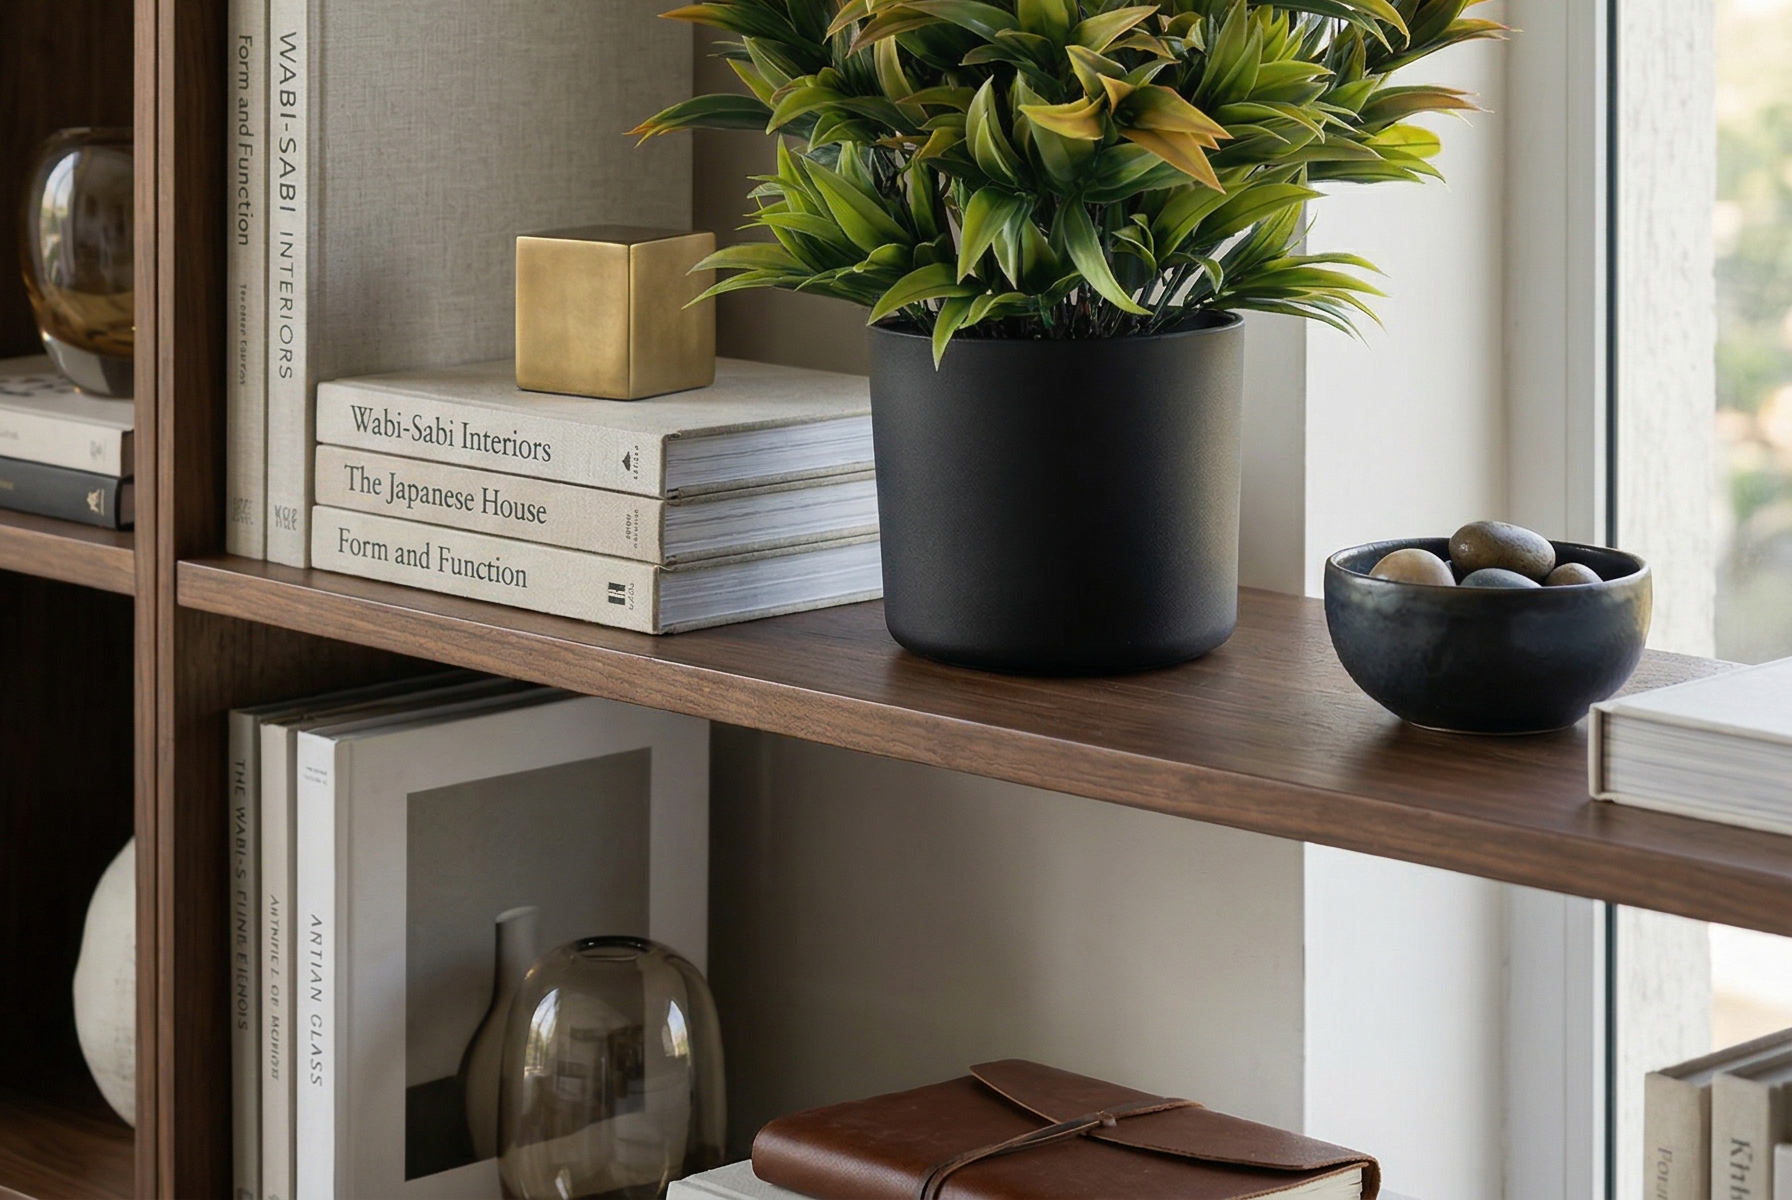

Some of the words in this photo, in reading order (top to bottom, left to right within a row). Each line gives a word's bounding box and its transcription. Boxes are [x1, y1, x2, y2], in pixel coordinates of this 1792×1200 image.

[237, 34, 253, 91] Form
[238, 97, 255, 138] and
[278, 31, 298, 212] WABI-SABI
[237, 142, 254, 246] Function
[278, 231, 294, 379] INTERIORS
[350, 404, 455, 448] Wabi-Sabi
[460, 422, 552, 463] Interiors
[344, 464, 382, 496] The
[385, 471, 475, 512] Japanese
[480, 486, 548, 524] House
[338, 527, 389, 562] Form
[394, 542, 431, 570] and
[437, 545, 528, 589] Function
